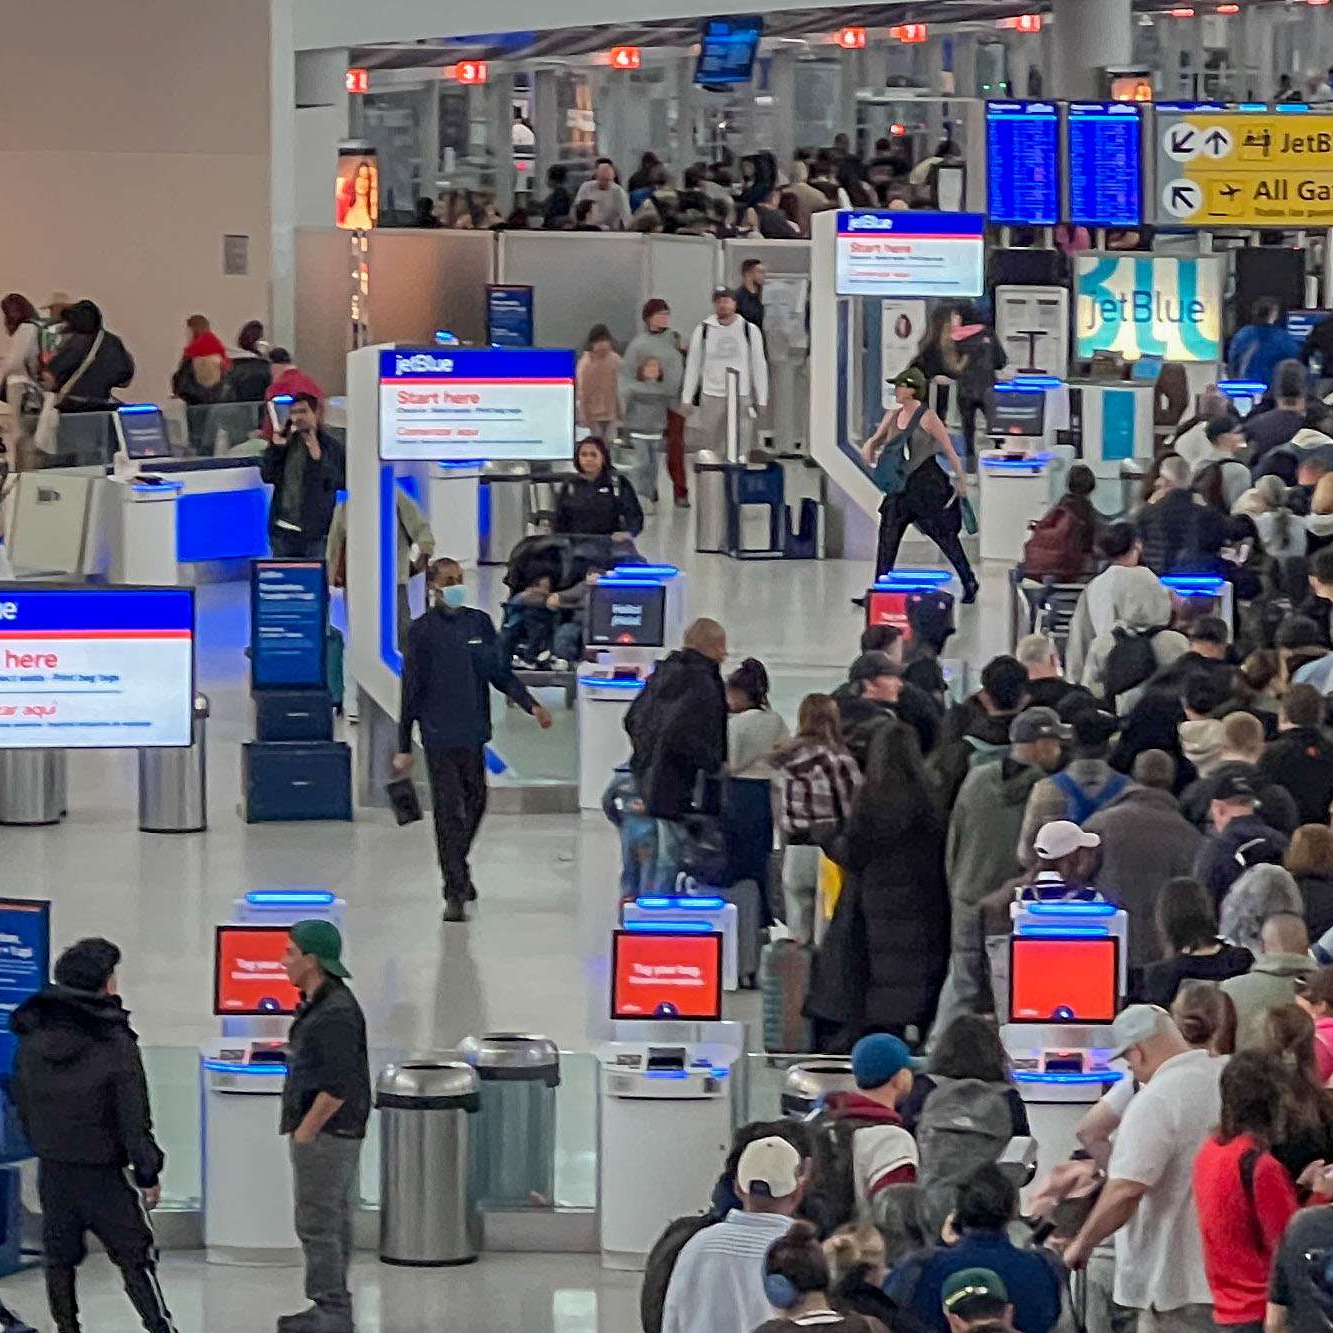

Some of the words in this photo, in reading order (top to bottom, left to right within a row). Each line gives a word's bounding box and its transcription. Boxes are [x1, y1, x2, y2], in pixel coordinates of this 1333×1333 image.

[1253, 179, 1289, 201] All
[1085, 289, 1205, 330] jetBlue
[397, 390, 439, 404] Start
[444, 390, 480, 404] here
[5, 649, 59, 669] here
